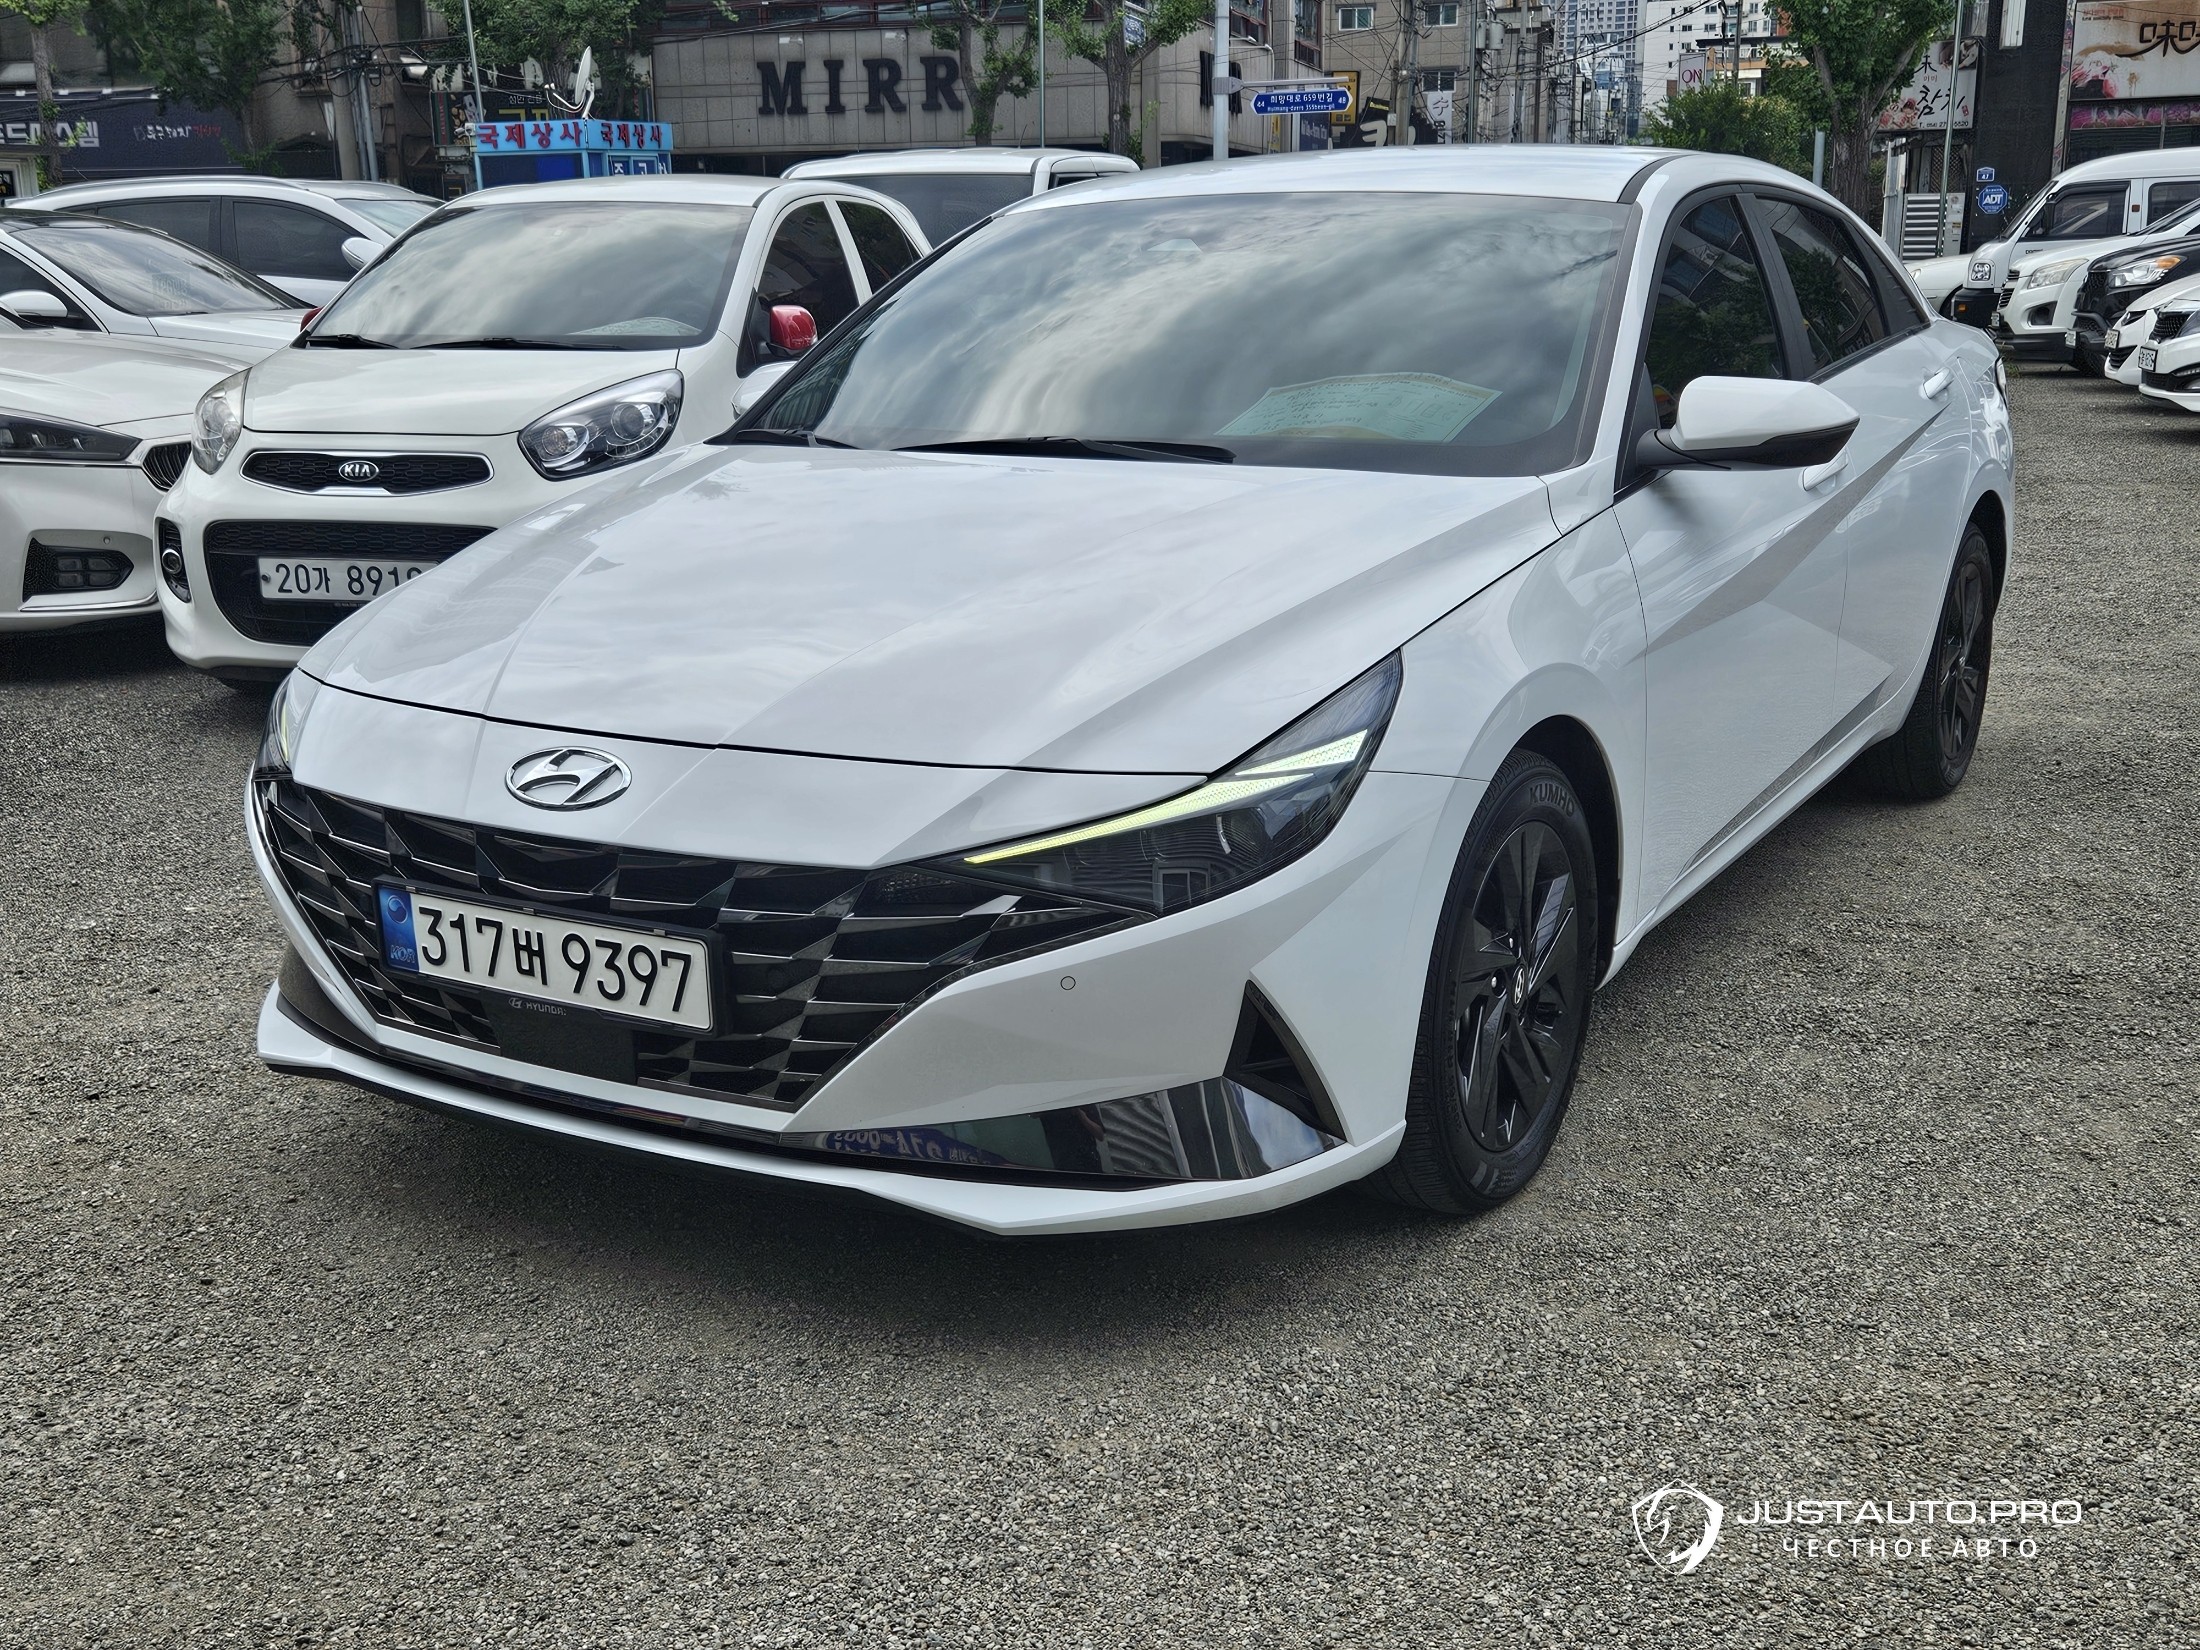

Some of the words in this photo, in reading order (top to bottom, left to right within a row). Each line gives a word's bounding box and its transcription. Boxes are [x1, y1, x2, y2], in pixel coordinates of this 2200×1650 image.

[757, 56, 965, 116] MIRR
[476, 121, 582, 149] 국제상사
[601, 121, 663, 149] 국제상사
[1982, 194, 2003, 205] ADT
[344, 463, 371, 477] KIA
[275, 563, 331, 594] 20가
[1530, 782, 1574, 817] KUMHO
[390, 943, 416, 964] KOR
[418, 906, 547, 986] 317버
[561, 932, 692, 1012] 9397
[526, 1002, 567, 1016] HYUNDAI
